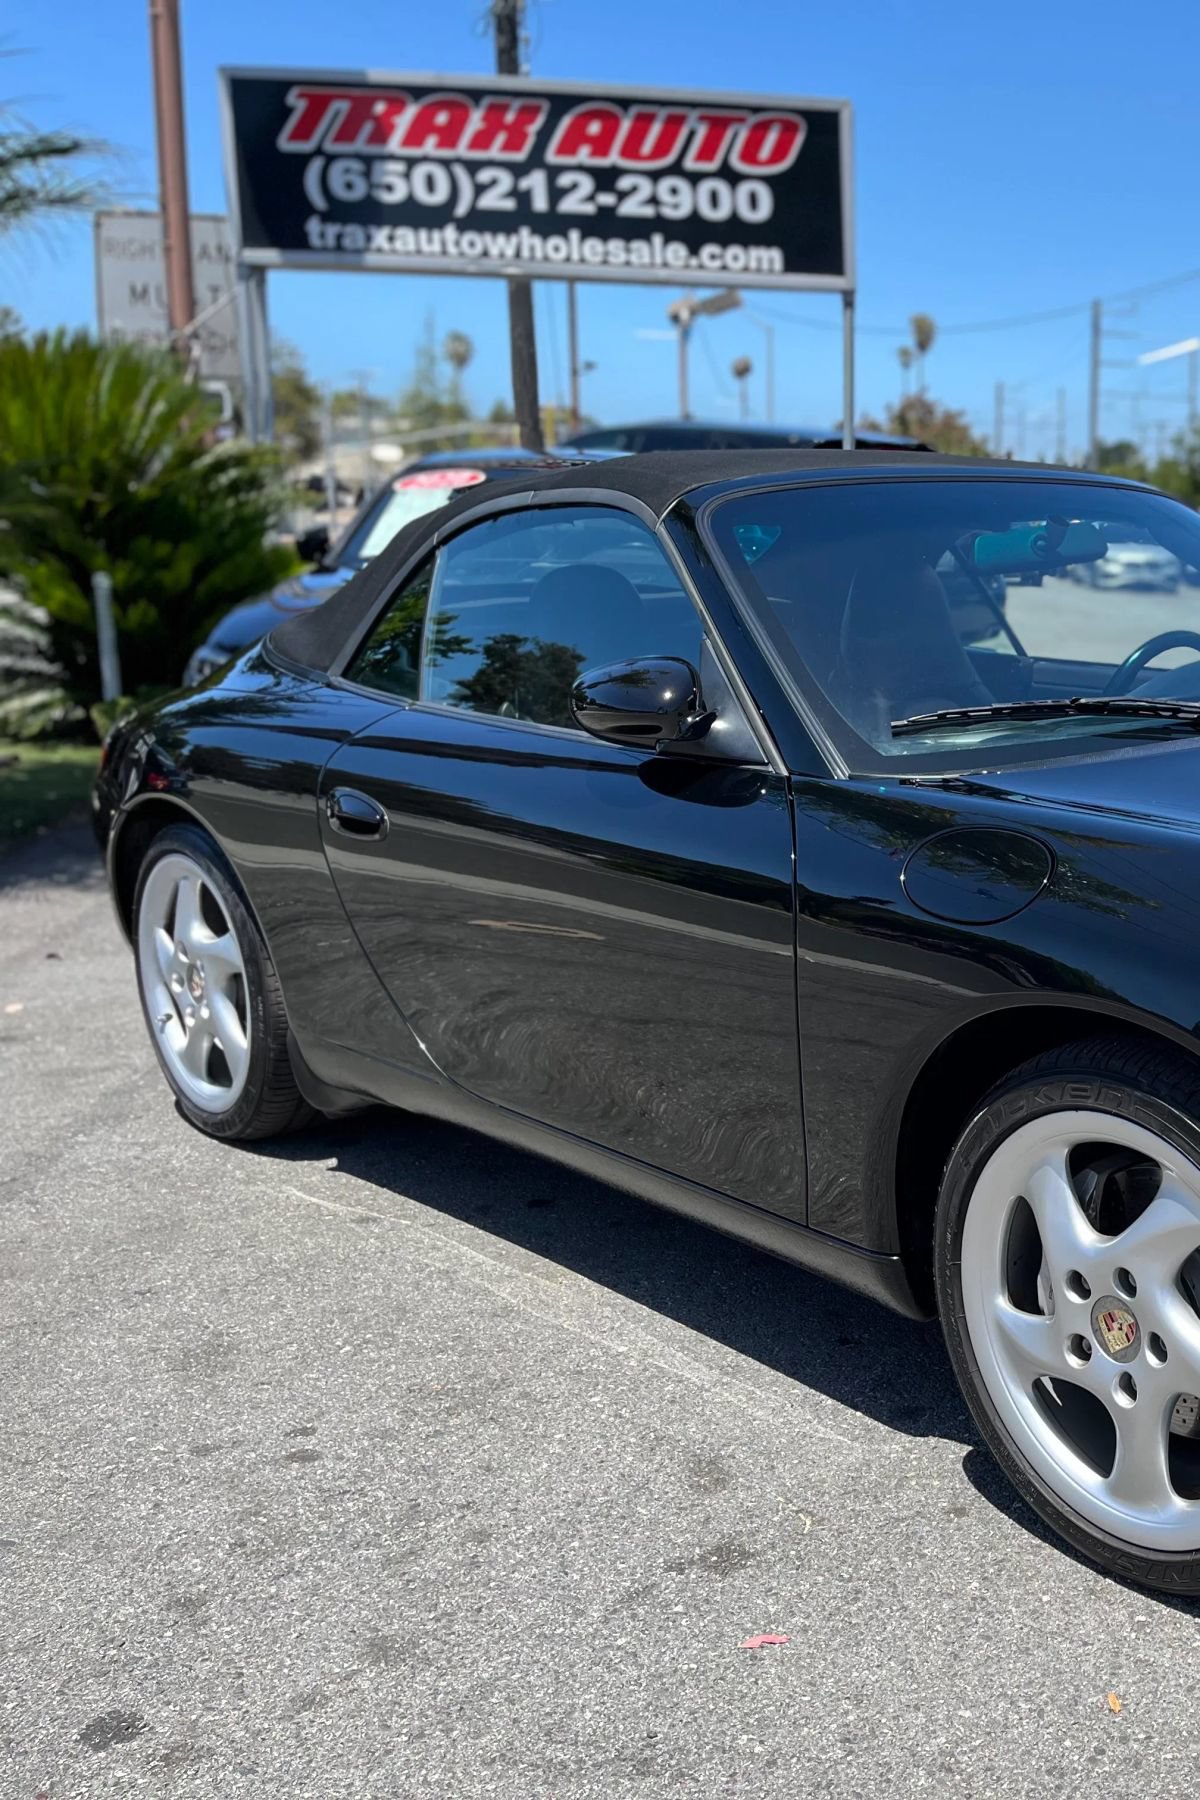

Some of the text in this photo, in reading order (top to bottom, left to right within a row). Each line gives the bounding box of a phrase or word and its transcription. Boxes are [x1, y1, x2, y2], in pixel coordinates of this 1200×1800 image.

[276, 84, 808, 176] TRAX AUTO
[303, 155, 774, 224] (650)212-2900
[103, 236, 158, 262] RIGH
[305, 213, 784, 273] traxautowholesale.com
[128, 284, 221, 309] MUT
